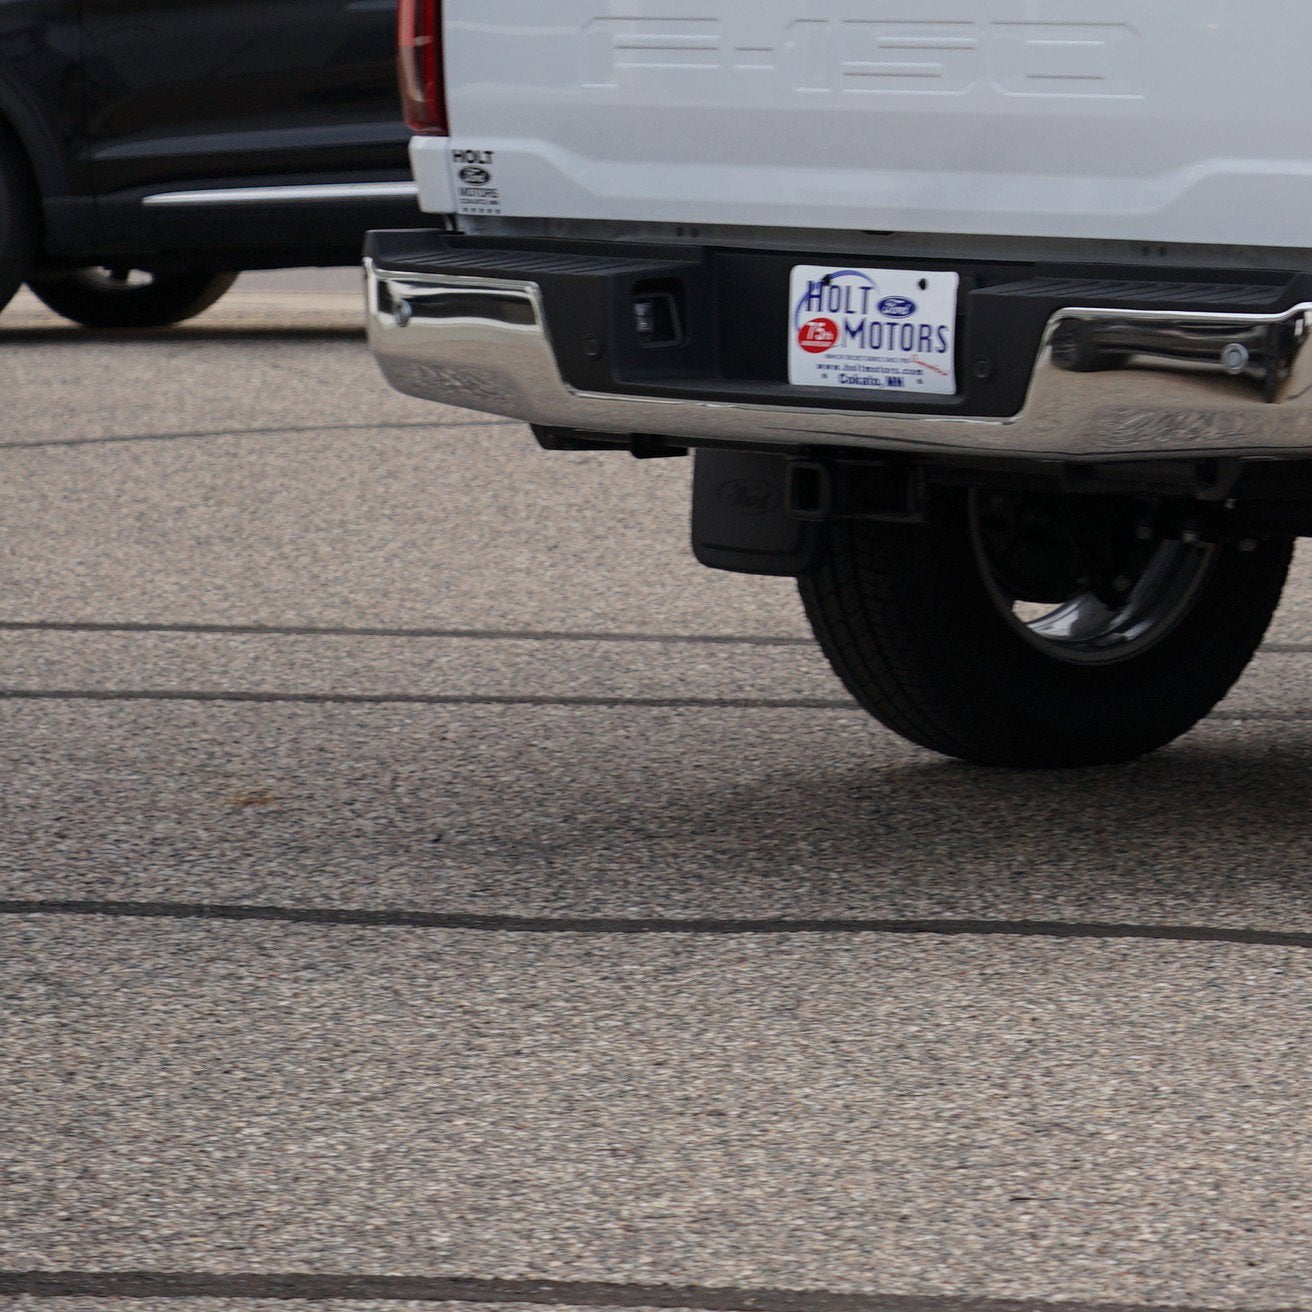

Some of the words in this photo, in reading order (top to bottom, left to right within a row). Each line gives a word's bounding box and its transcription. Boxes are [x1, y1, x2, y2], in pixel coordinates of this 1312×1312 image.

[577, 17, 1145, 99] F-150
[452, 149, 495, 165] HOLT
[458, 187, 499, 198] MOTORS
[806, 280, 875, 315] HOLT
[881, 299, 912, 315] Ford
[842, 317, 950, 354] MOTORS
